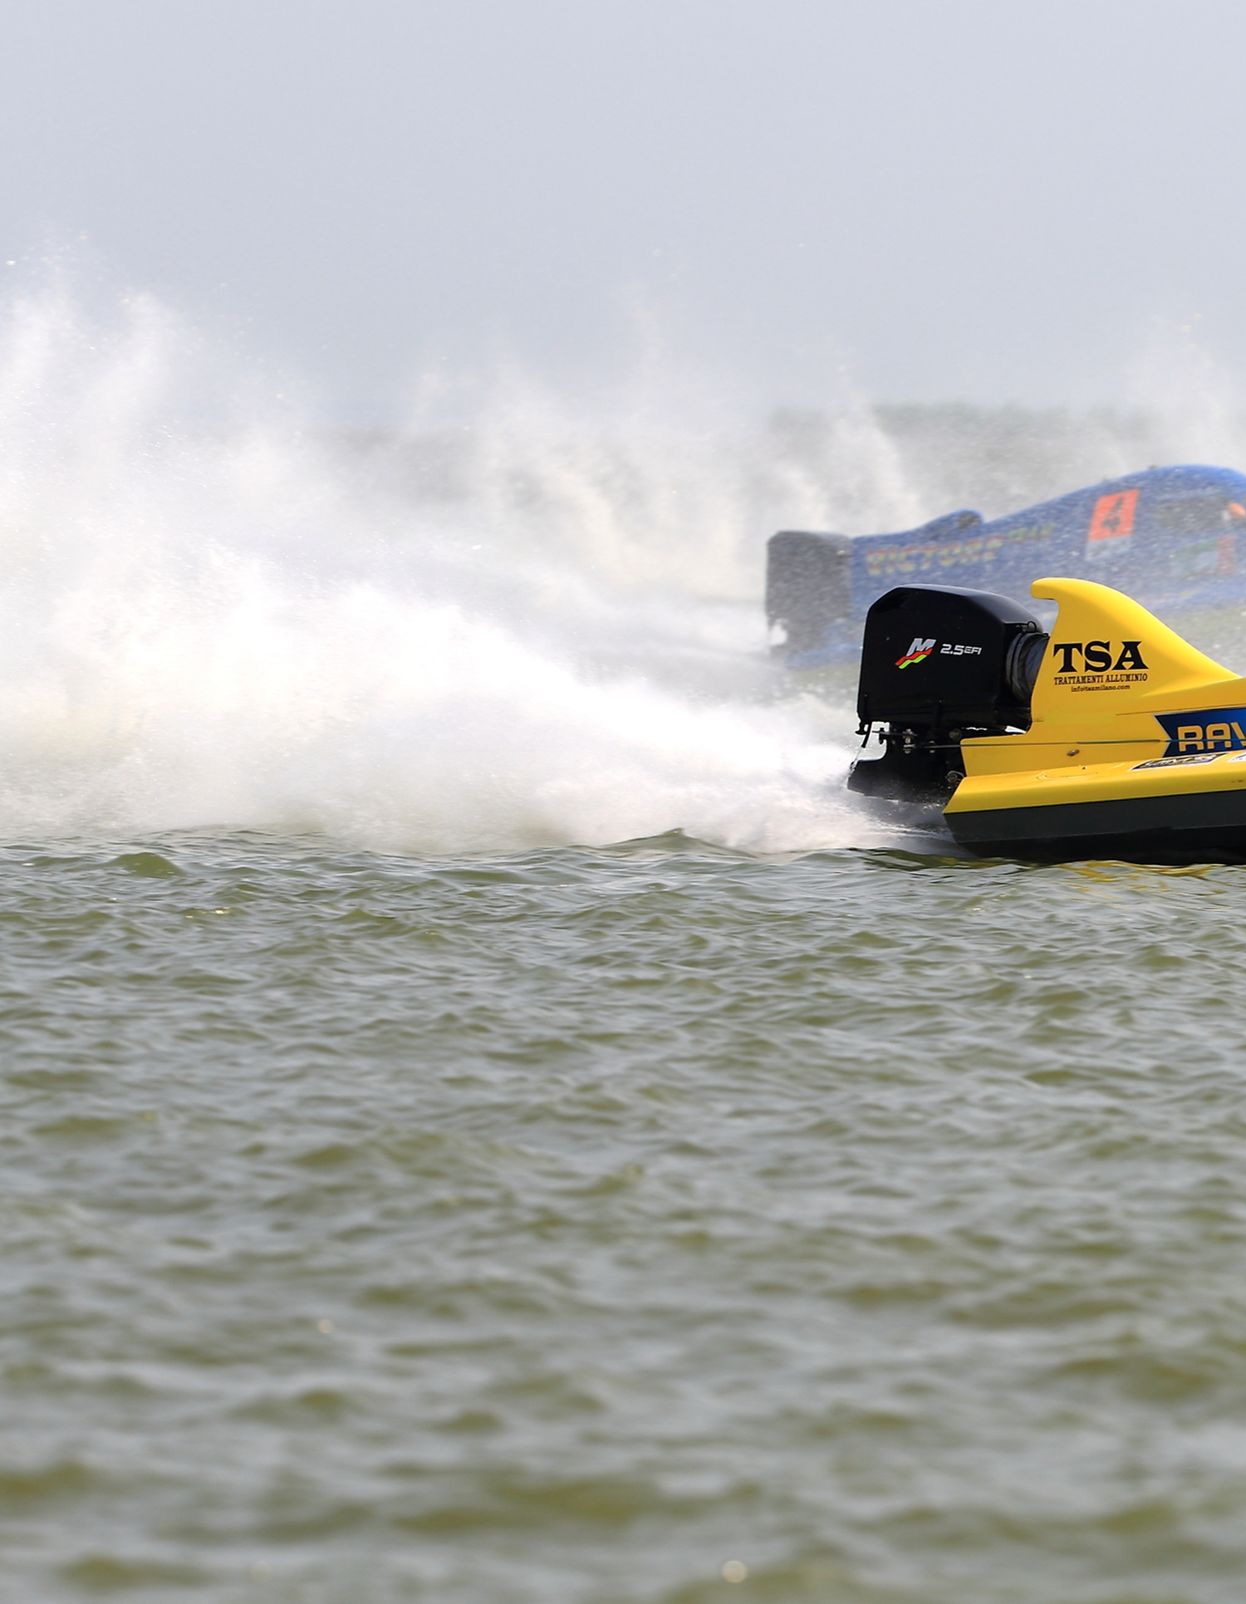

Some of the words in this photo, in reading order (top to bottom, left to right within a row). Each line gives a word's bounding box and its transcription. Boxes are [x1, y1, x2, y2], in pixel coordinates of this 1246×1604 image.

[1101, 496, 1123, 532] 4
[1053, 640, 1149, 673] TSA
[1054, 674, 1104, 686] TRATTAMENTI
[1105, 673, 1148, 683] ALLUMINIO
